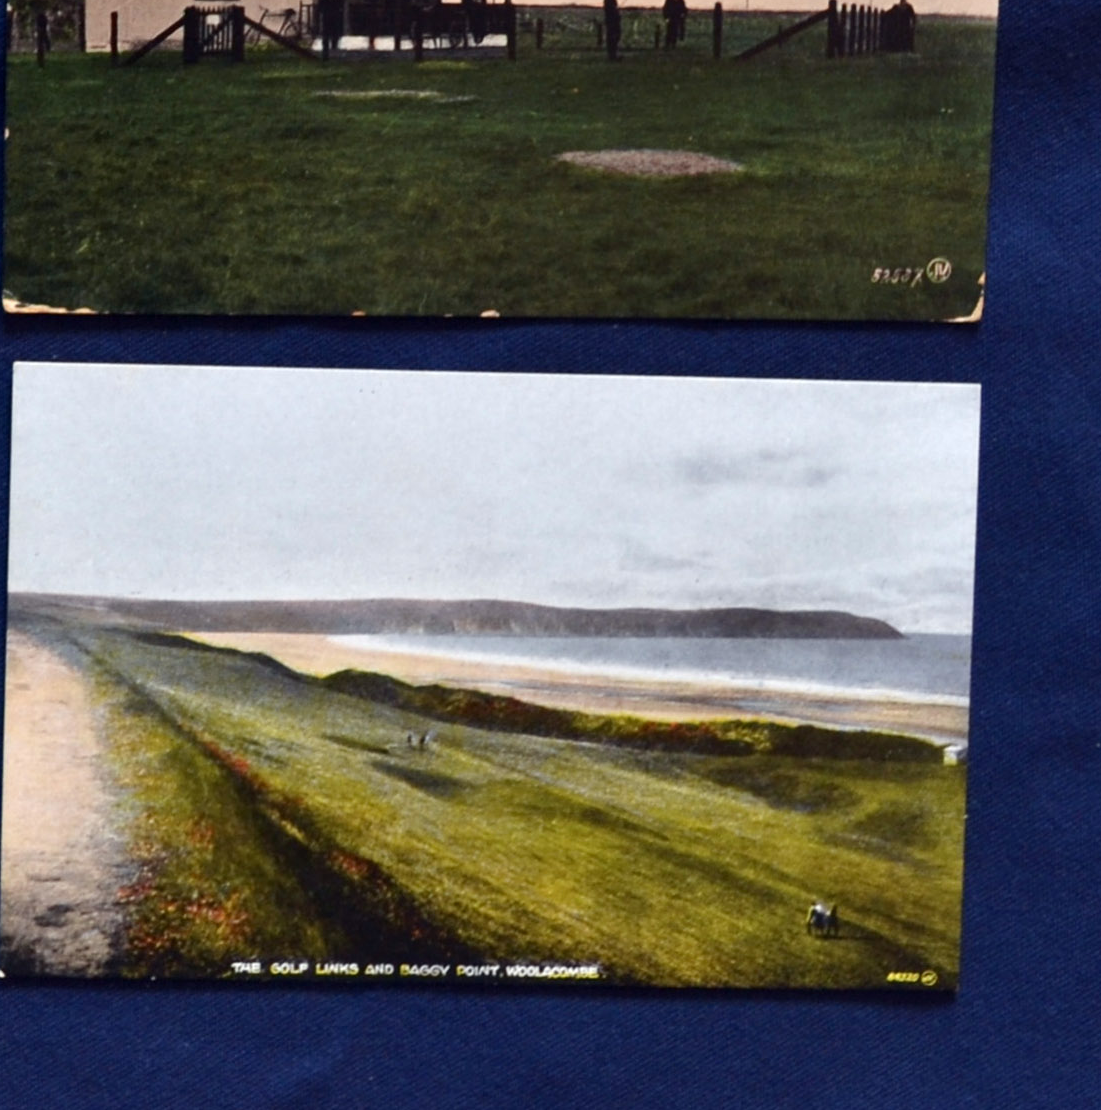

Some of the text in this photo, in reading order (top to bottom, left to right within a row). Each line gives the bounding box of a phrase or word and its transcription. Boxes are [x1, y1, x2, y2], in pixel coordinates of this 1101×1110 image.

[231, 962, 261, 974] THE
[270, 963, 309, 975] GOLF
[316, 963, 359, 975] LINKS
[365, 963, 395, 975] AND
[400, 964, 450, 976] BAGGY
